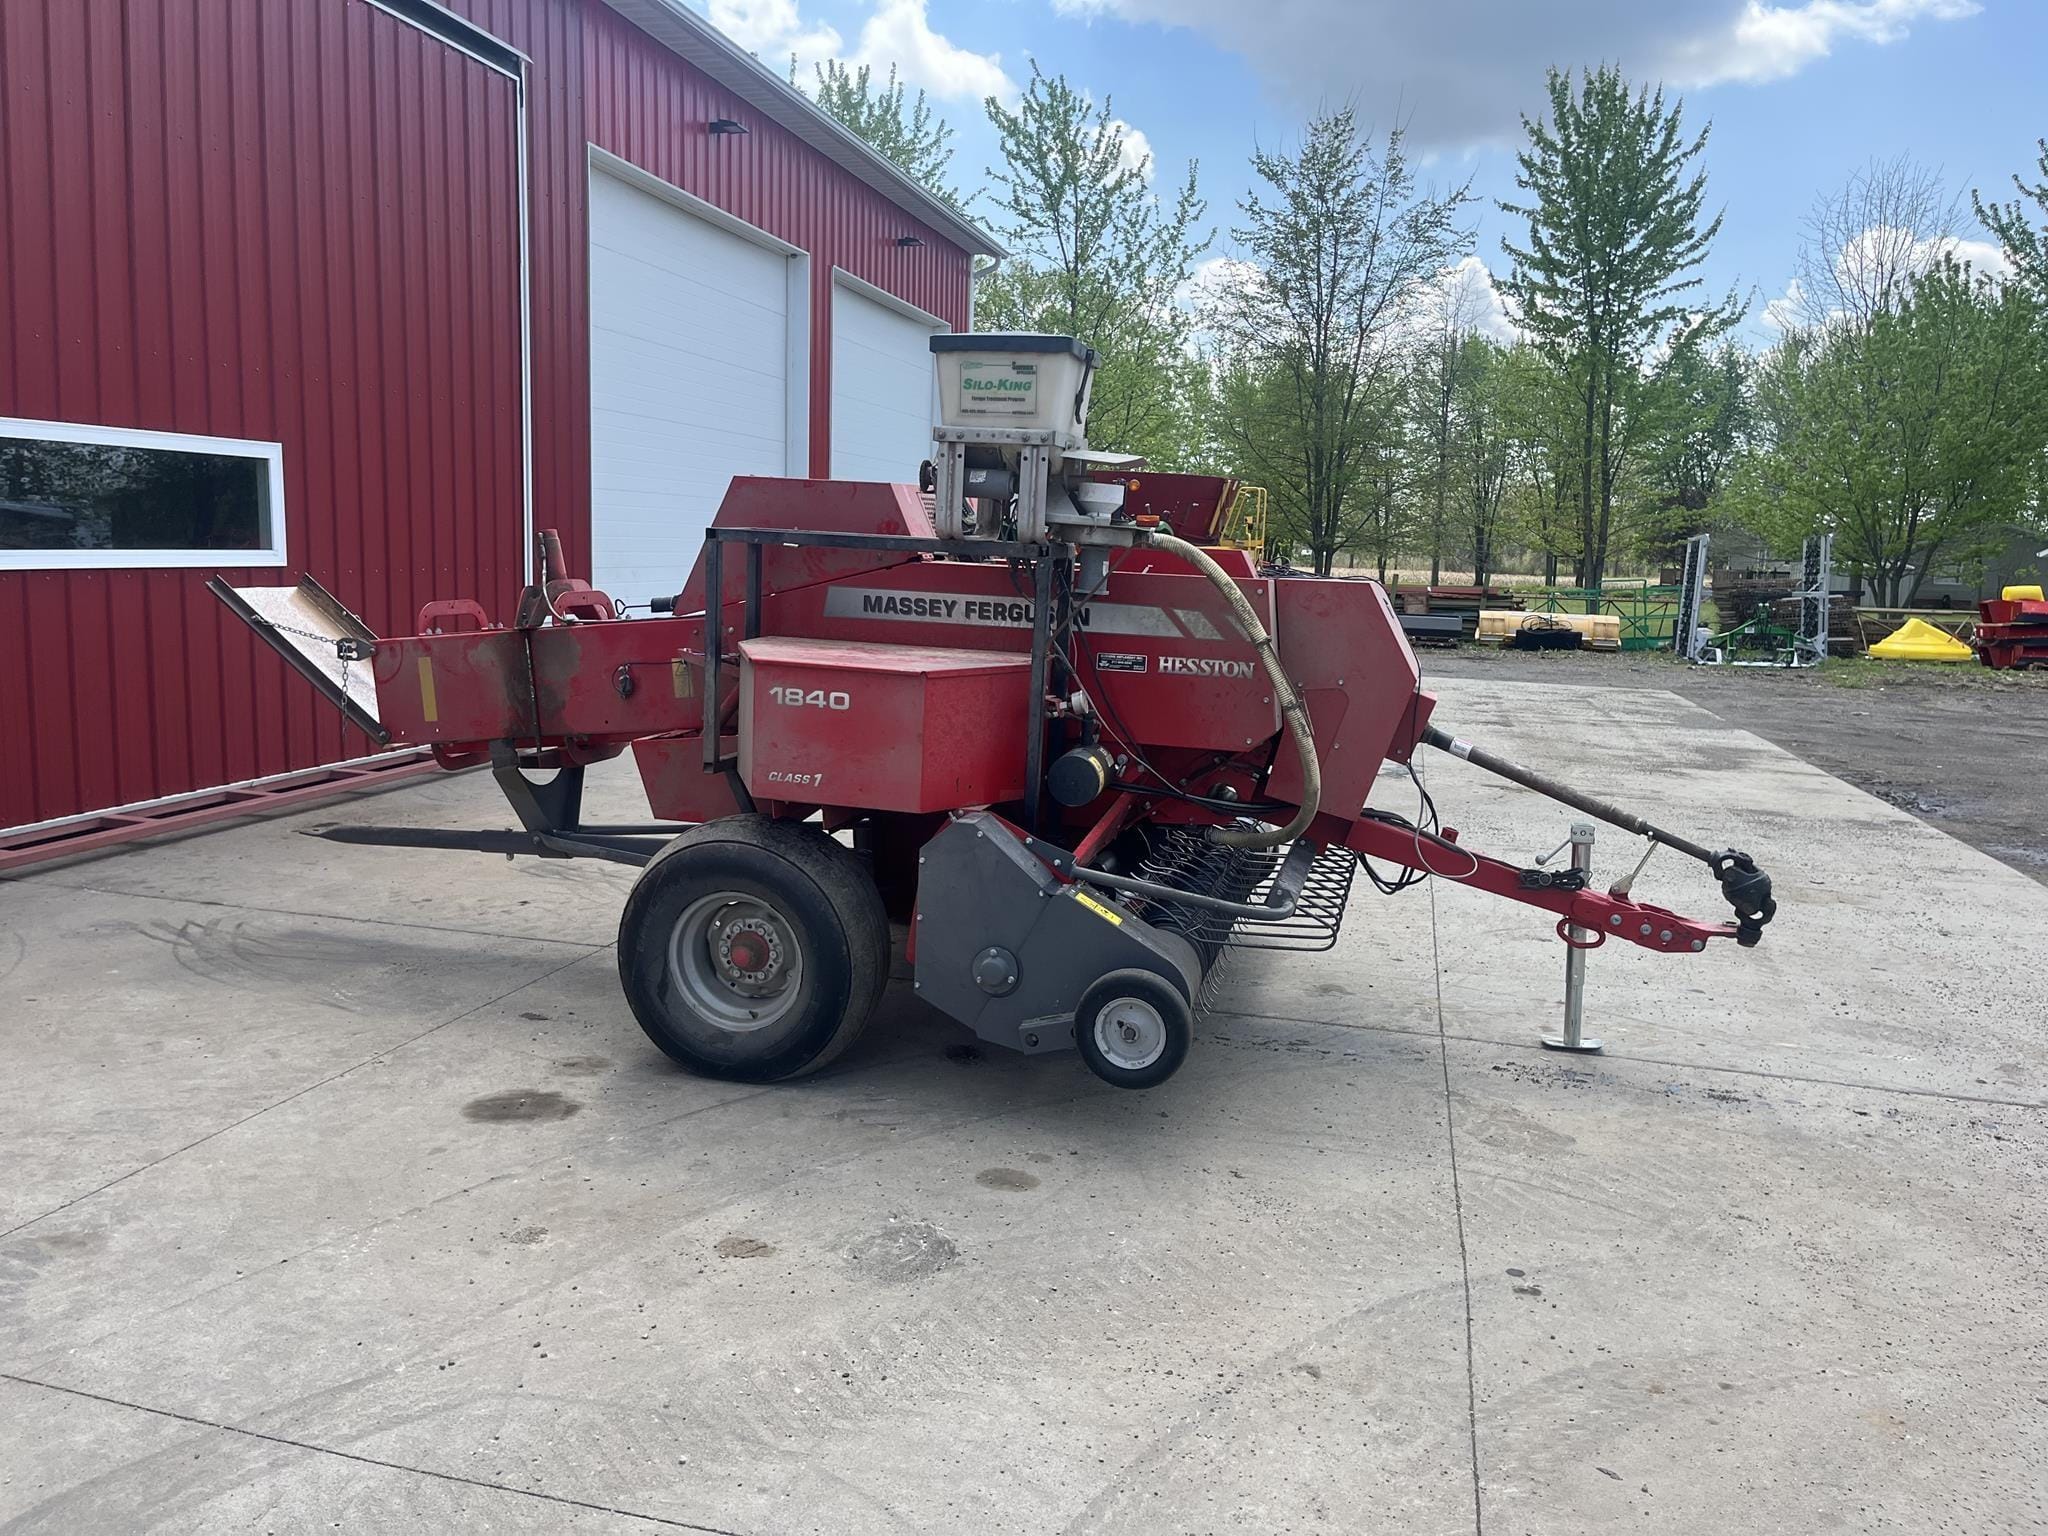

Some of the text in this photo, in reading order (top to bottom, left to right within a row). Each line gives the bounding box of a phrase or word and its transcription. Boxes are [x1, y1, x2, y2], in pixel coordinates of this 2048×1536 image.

[863, 595, 957, 618] MASSEY
[1158, 656, 1255, 679] HESSTON
[769, 686, 850, 710] 1840
[768, 771, 823, 787] CLASS 1
